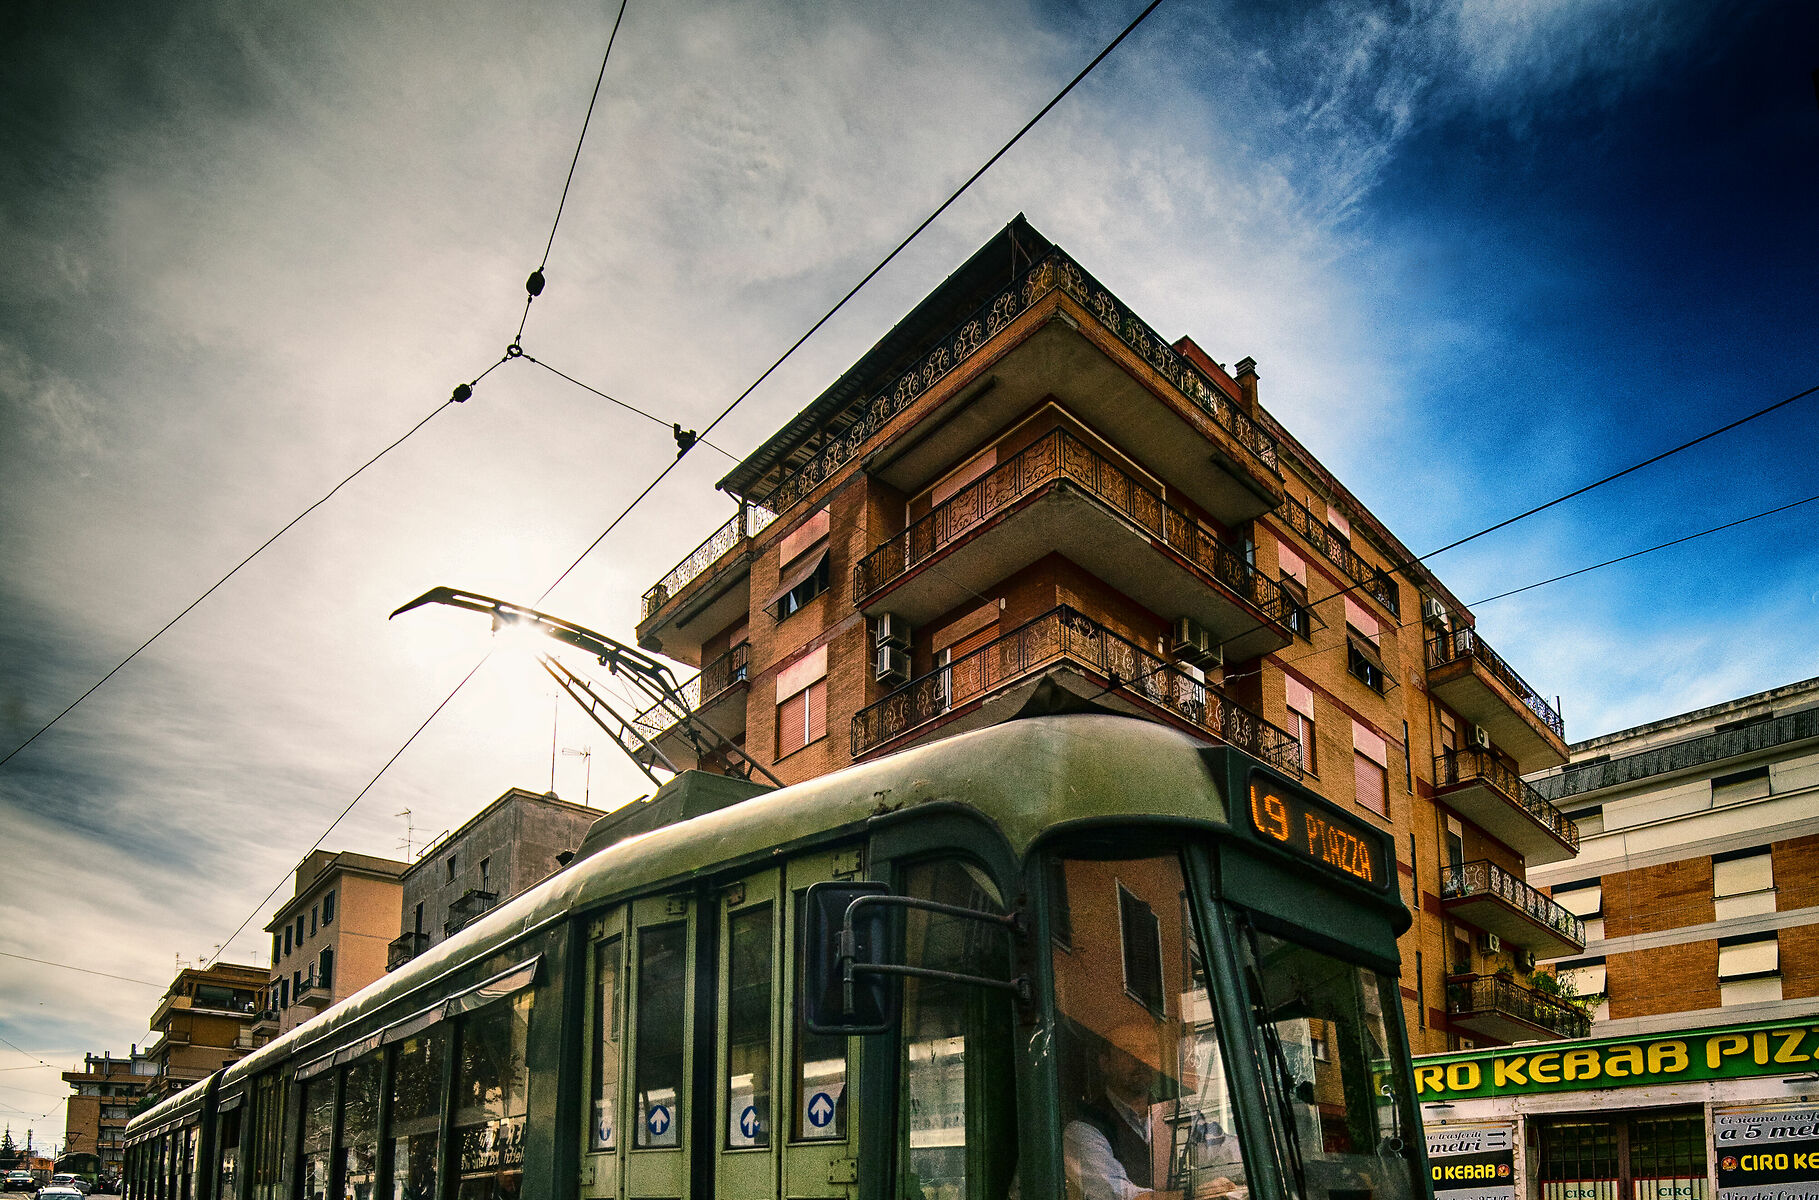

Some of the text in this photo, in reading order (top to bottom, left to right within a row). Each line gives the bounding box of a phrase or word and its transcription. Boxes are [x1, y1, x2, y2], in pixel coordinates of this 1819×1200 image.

[1304, 812, 1373, 883] PIAZZA
[1706, 1026, 1819, 1069] PIZ
[1720, 1129, 1737, 1140] a
[1744, 1123, 1762, 1139] 5
[1429, 1139, 1482, 1153] metri
[1740, 1152, 1819, 1171] CIRO KE
[1565, 1189, 1596, 1199] CIRO
[1658, 1187, 1693, 1197] CIRO
